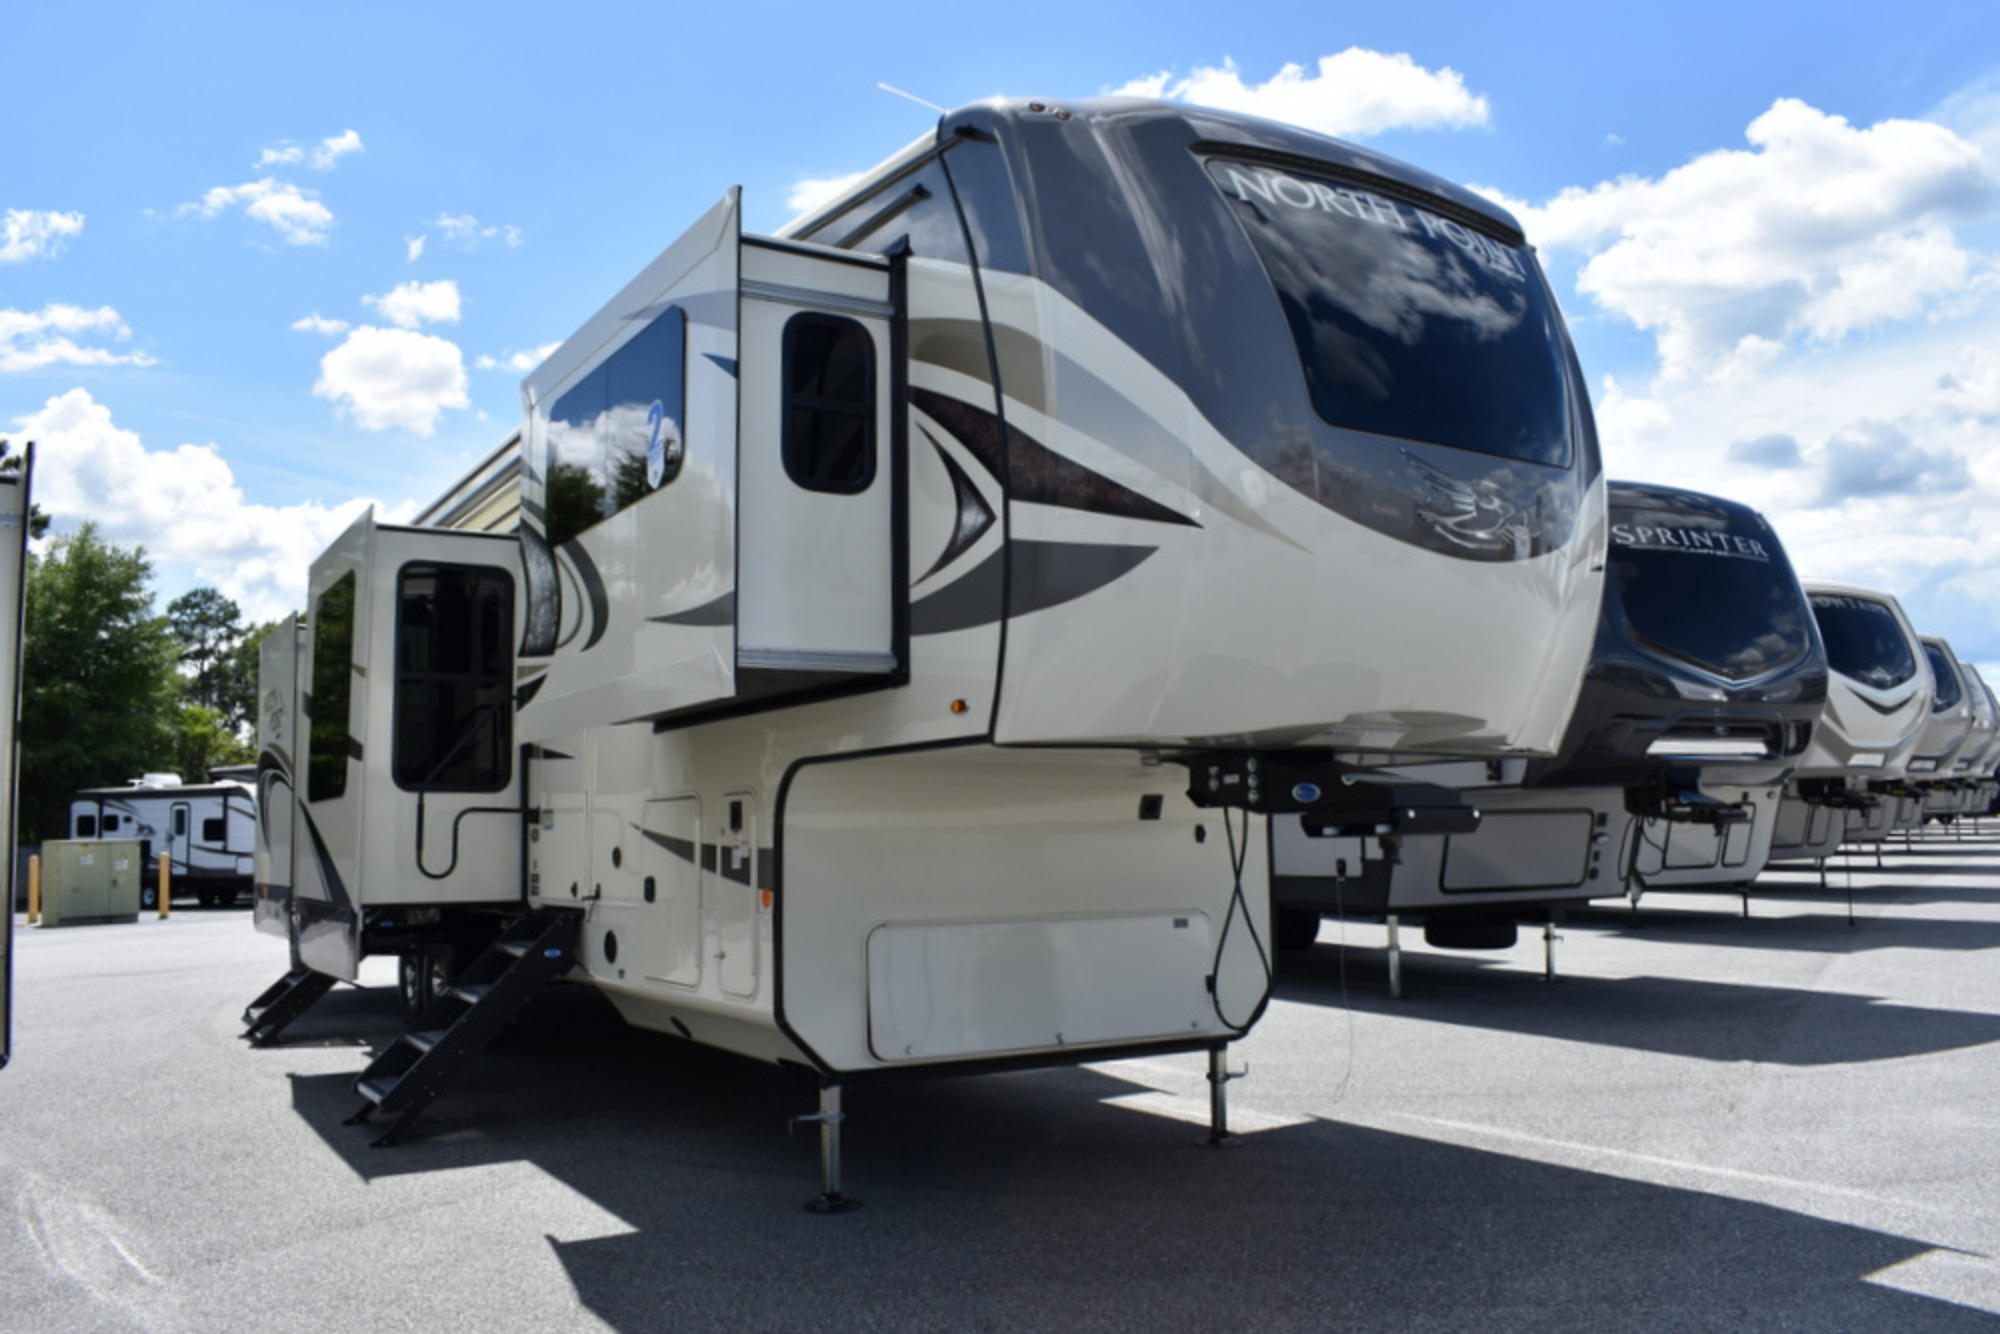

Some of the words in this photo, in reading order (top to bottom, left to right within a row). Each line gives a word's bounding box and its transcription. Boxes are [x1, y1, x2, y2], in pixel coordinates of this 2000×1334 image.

[1227, 169, 1408, 231] NORTH
[1413, 208, 1527, 275] POINT
[1611, 523, 1769, 558] SPRINTER
